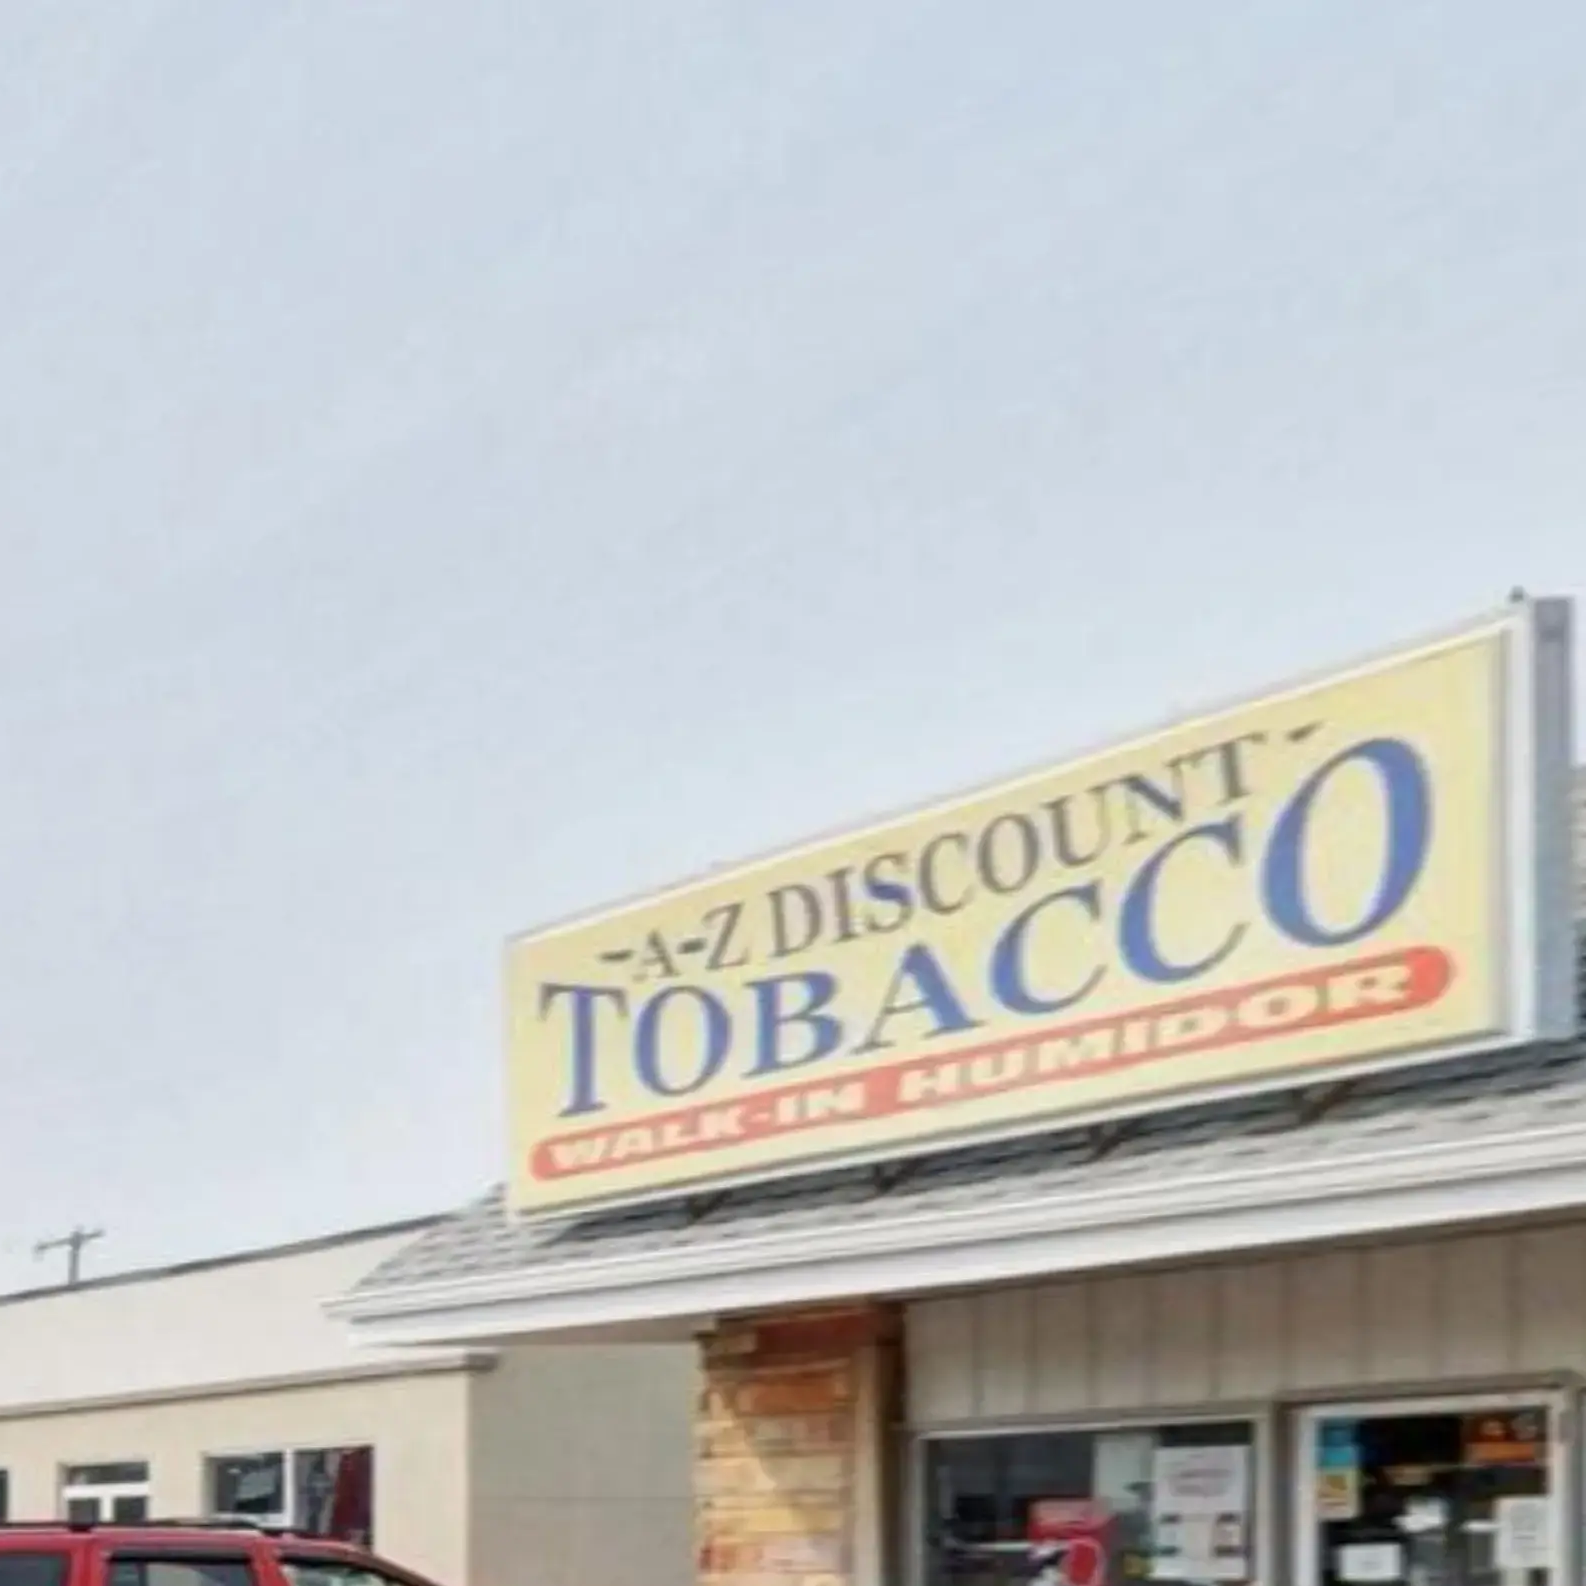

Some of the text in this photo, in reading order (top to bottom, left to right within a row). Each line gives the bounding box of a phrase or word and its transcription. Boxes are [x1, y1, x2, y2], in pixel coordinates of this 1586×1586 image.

[539, 736, 1433, 1118] TOBACCO
[548, 963, 1414, 1168] WALK-IN HUMIDOR
